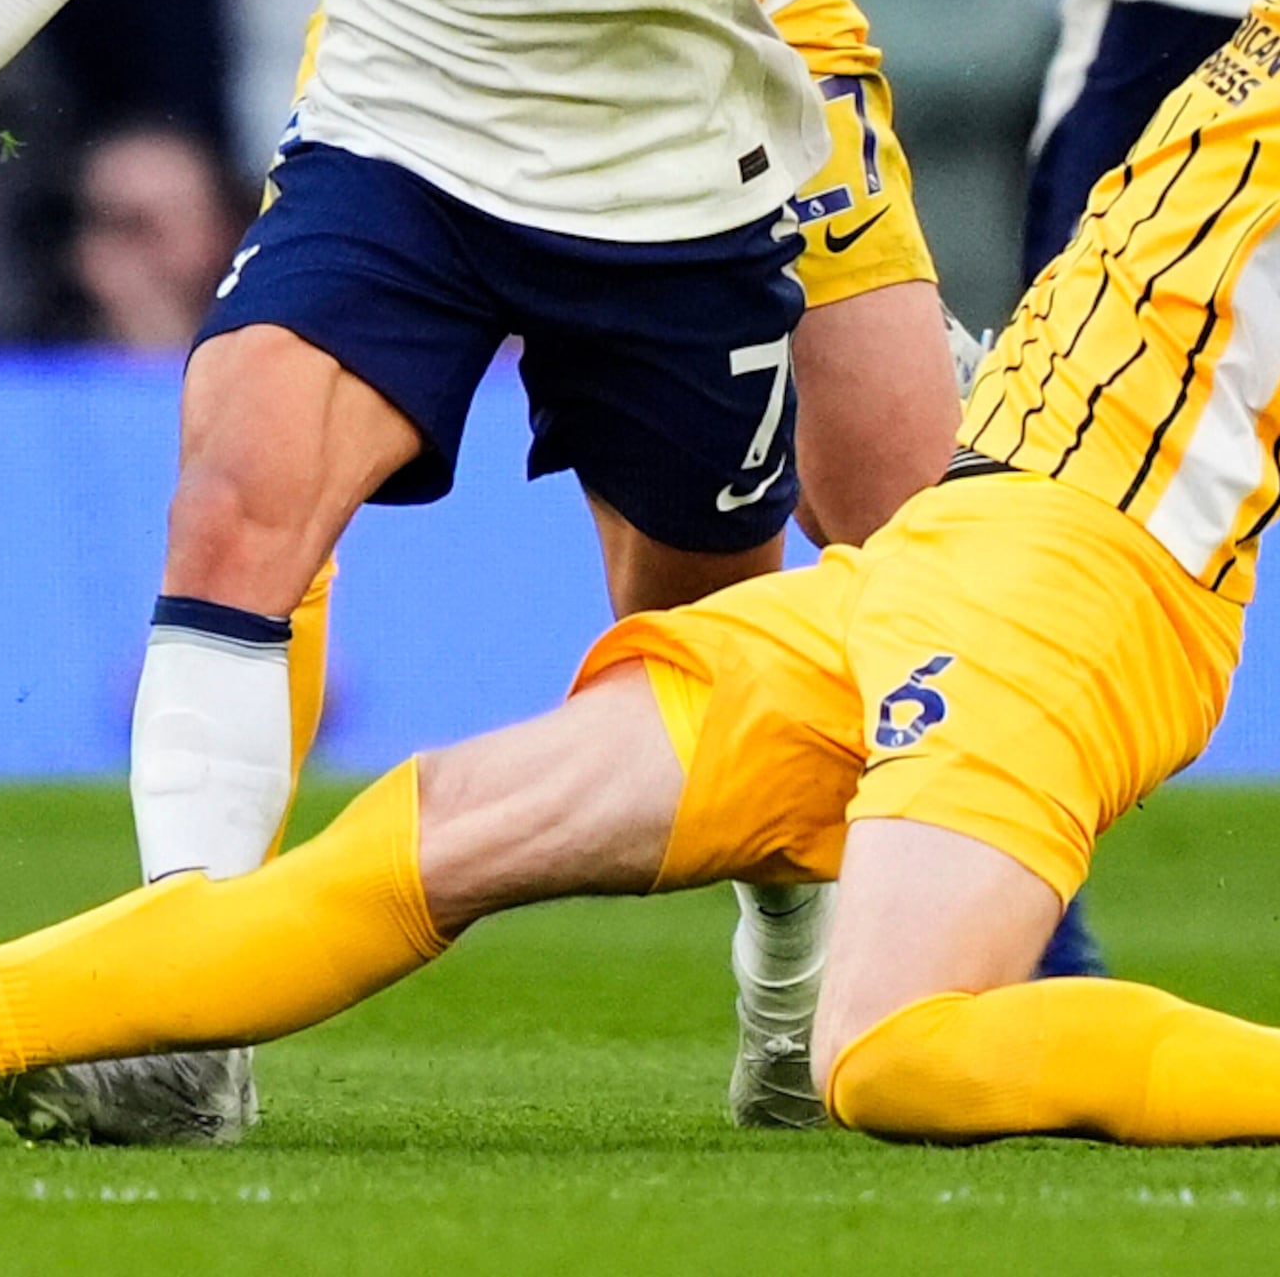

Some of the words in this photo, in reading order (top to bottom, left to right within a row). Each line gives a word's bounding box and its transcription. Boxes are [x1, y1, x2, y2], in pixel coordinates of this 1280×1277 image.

[786, 75, 882, 226] 7
[729, 331, 789, 470] 7
[875, 655, 954, 748] 6
